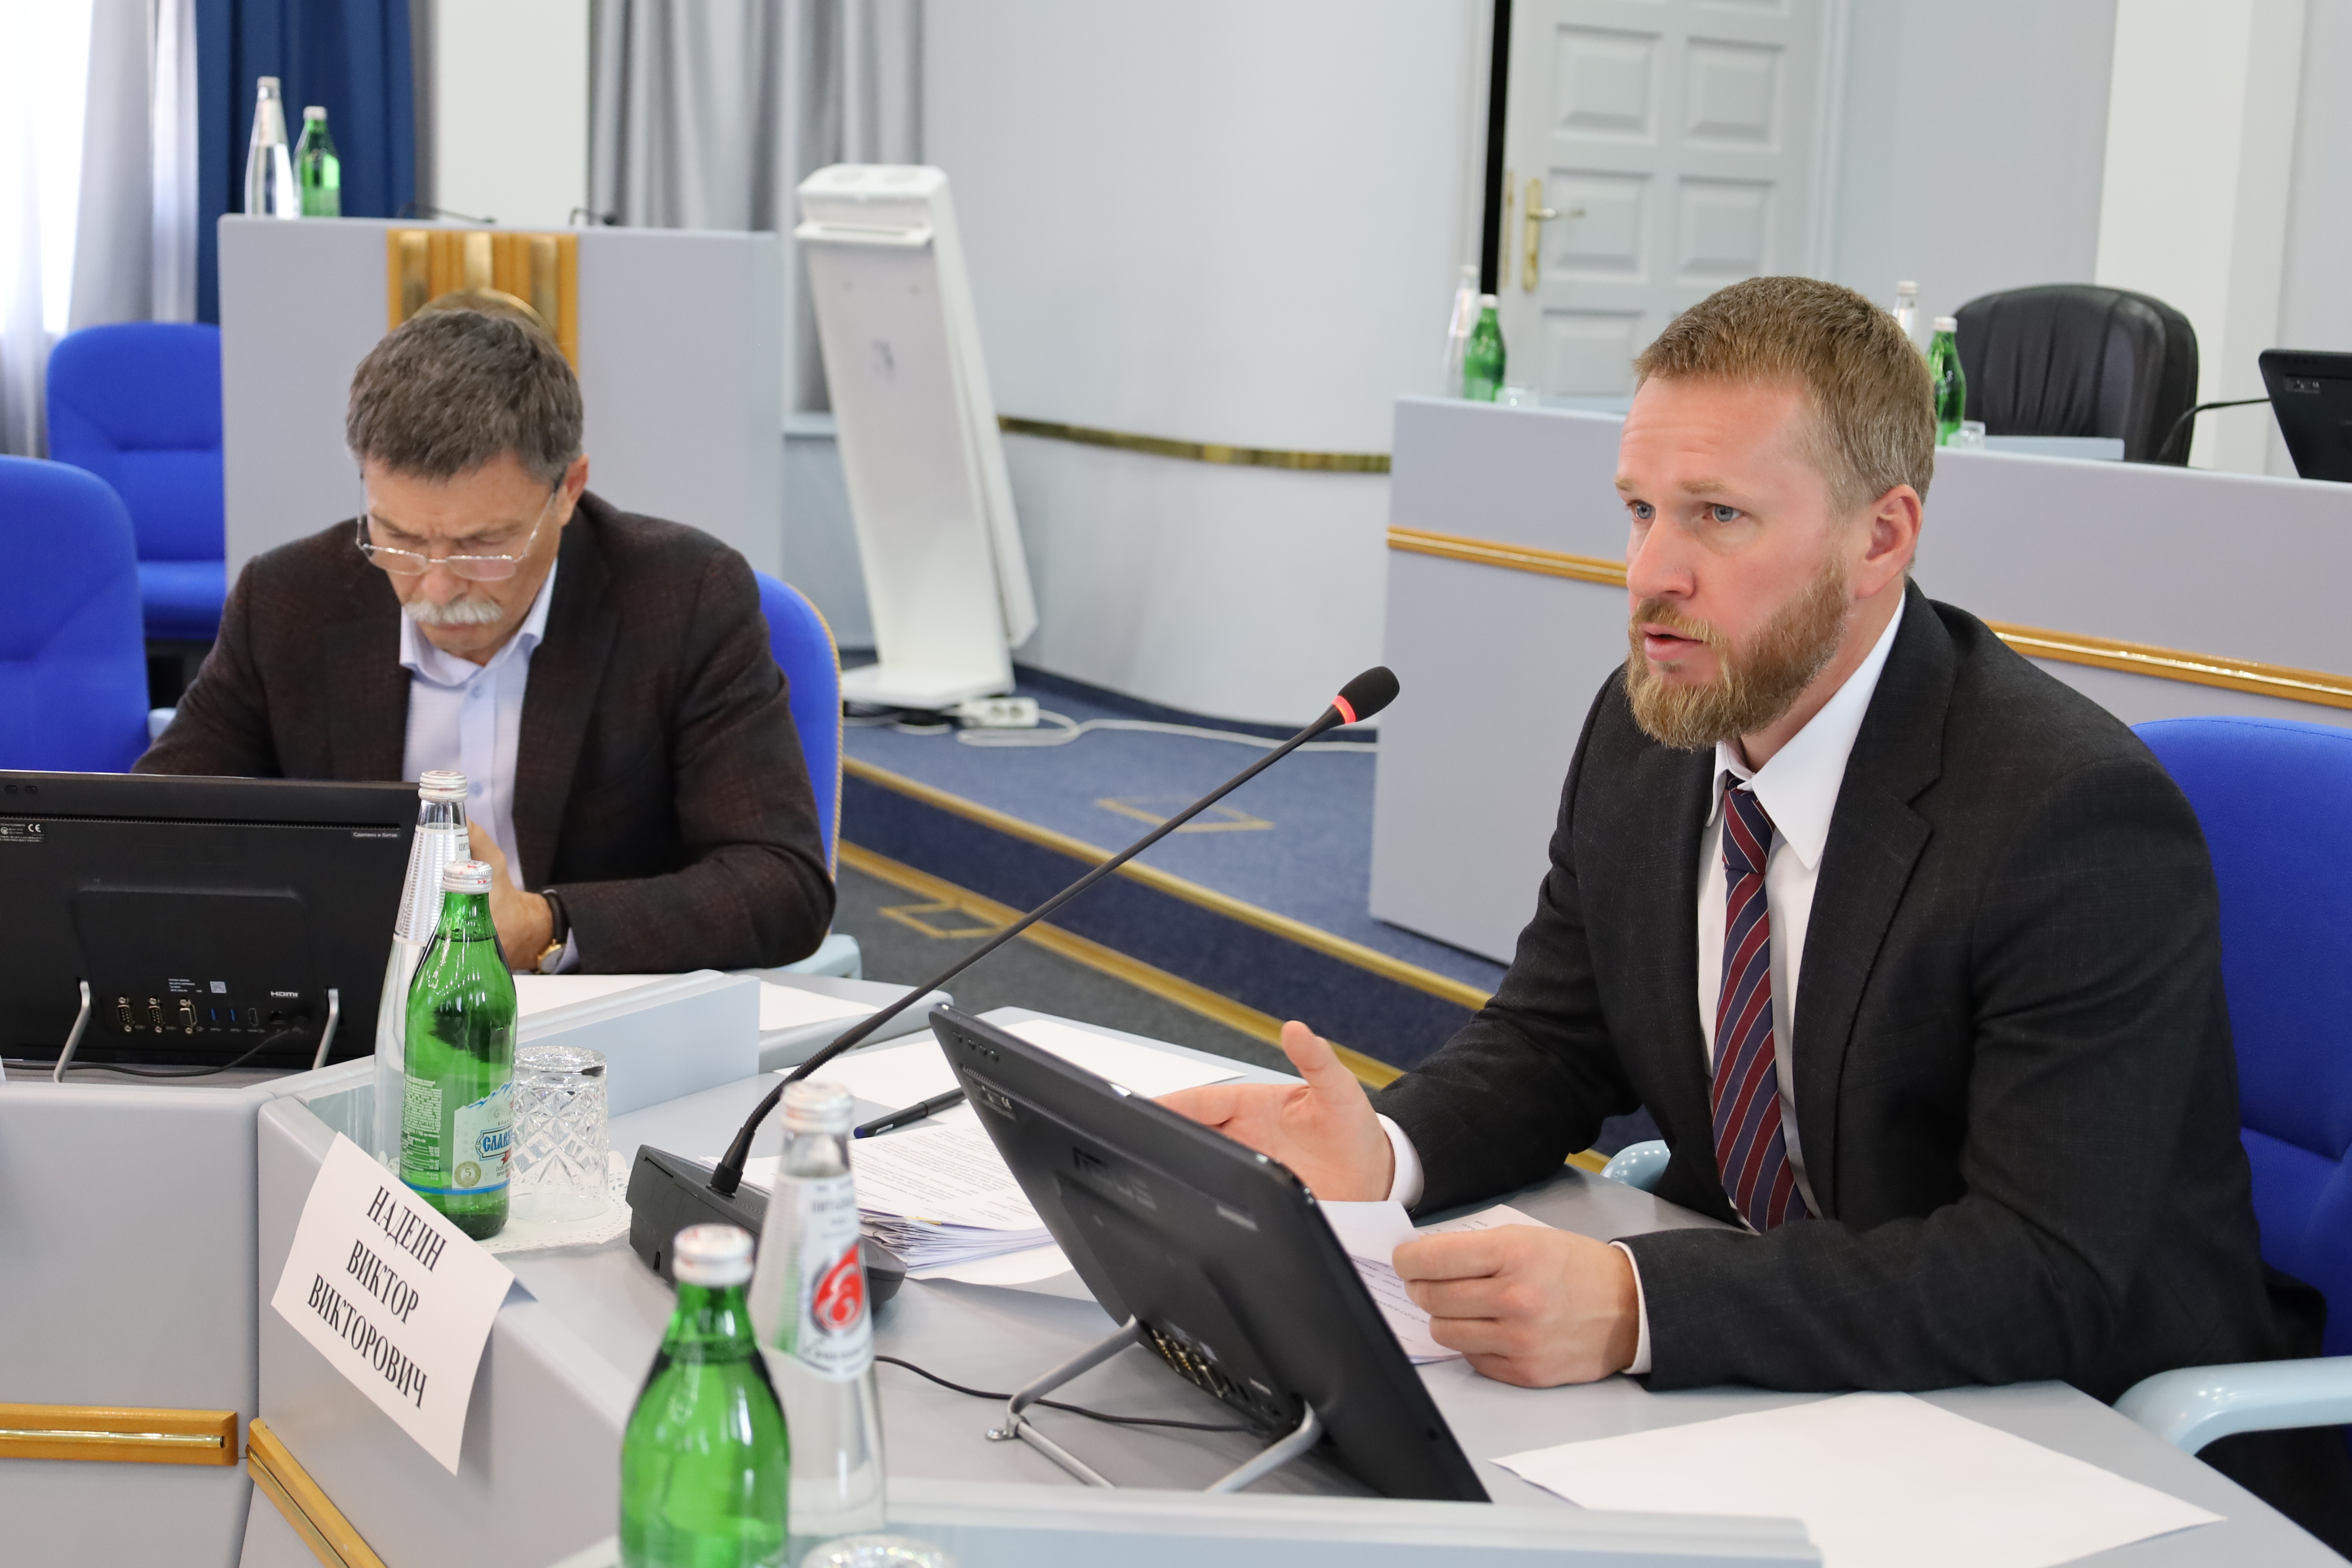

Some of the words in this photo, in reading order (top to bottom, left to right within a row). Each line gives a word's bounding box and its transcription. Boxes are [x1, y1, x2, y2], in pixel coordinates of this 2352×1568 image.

[28, 824, 41, 832] CE
[464, 1168, 472, 1177] 5
[366, 1186, 447, 1272] НАДЕИН
[346, 1239, 419, 1325] ВИКТОР
[307, 1273, 428, 1410] ВИКТОРОВИЧ
